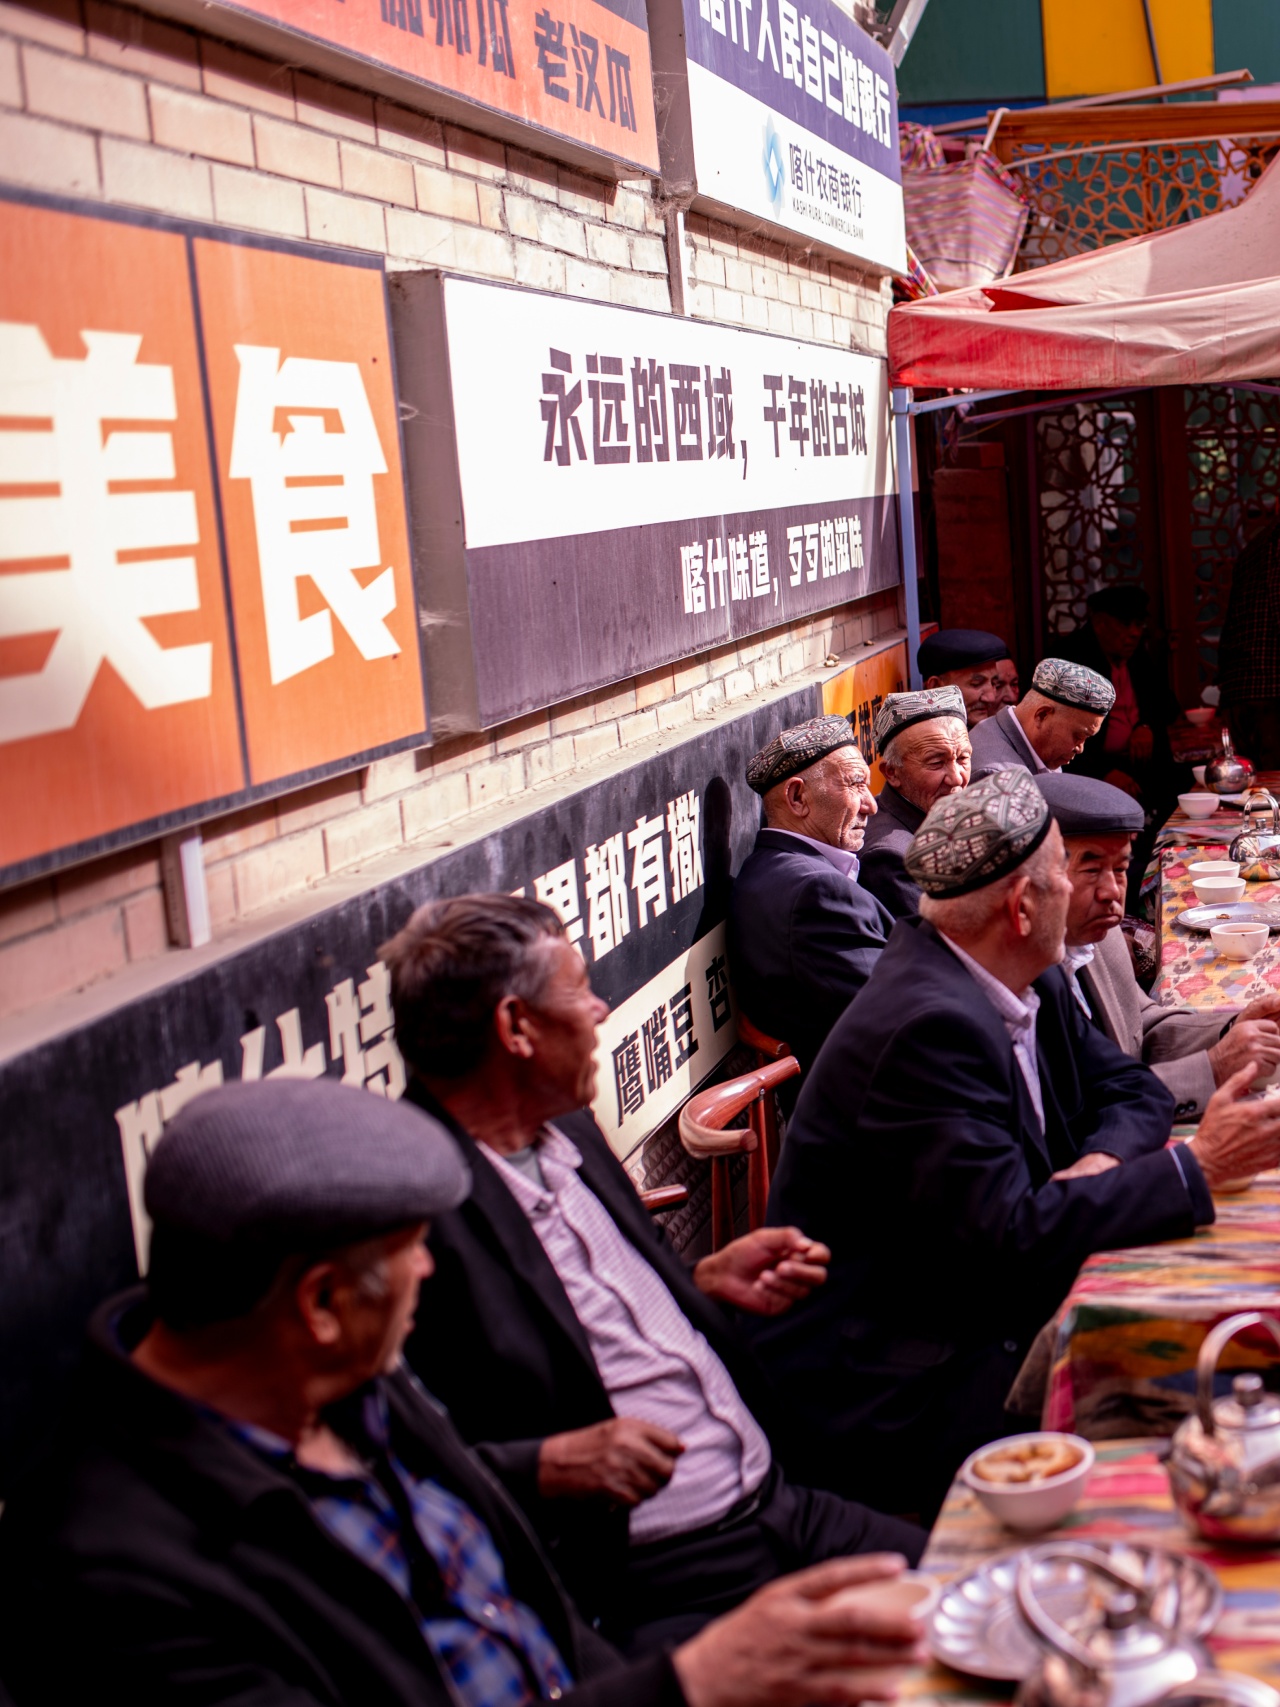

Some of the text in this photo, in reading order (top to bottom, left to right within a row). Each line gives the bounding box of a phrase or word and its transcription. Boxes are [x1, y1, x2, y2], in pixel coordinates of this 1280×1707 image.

[534, 8, 637, 133] 老汉瓜
[789, 143, 862, 219] 喀什农商银行
[792, 196, 808, 217] KASHI
[808, 204, 824, 224] RURAL
[825, 212, 852, 236] COMMERCIAL
[0, 321, 402, 745] 美食
[611, 982, 699, 1128] 鹰嘴豆
